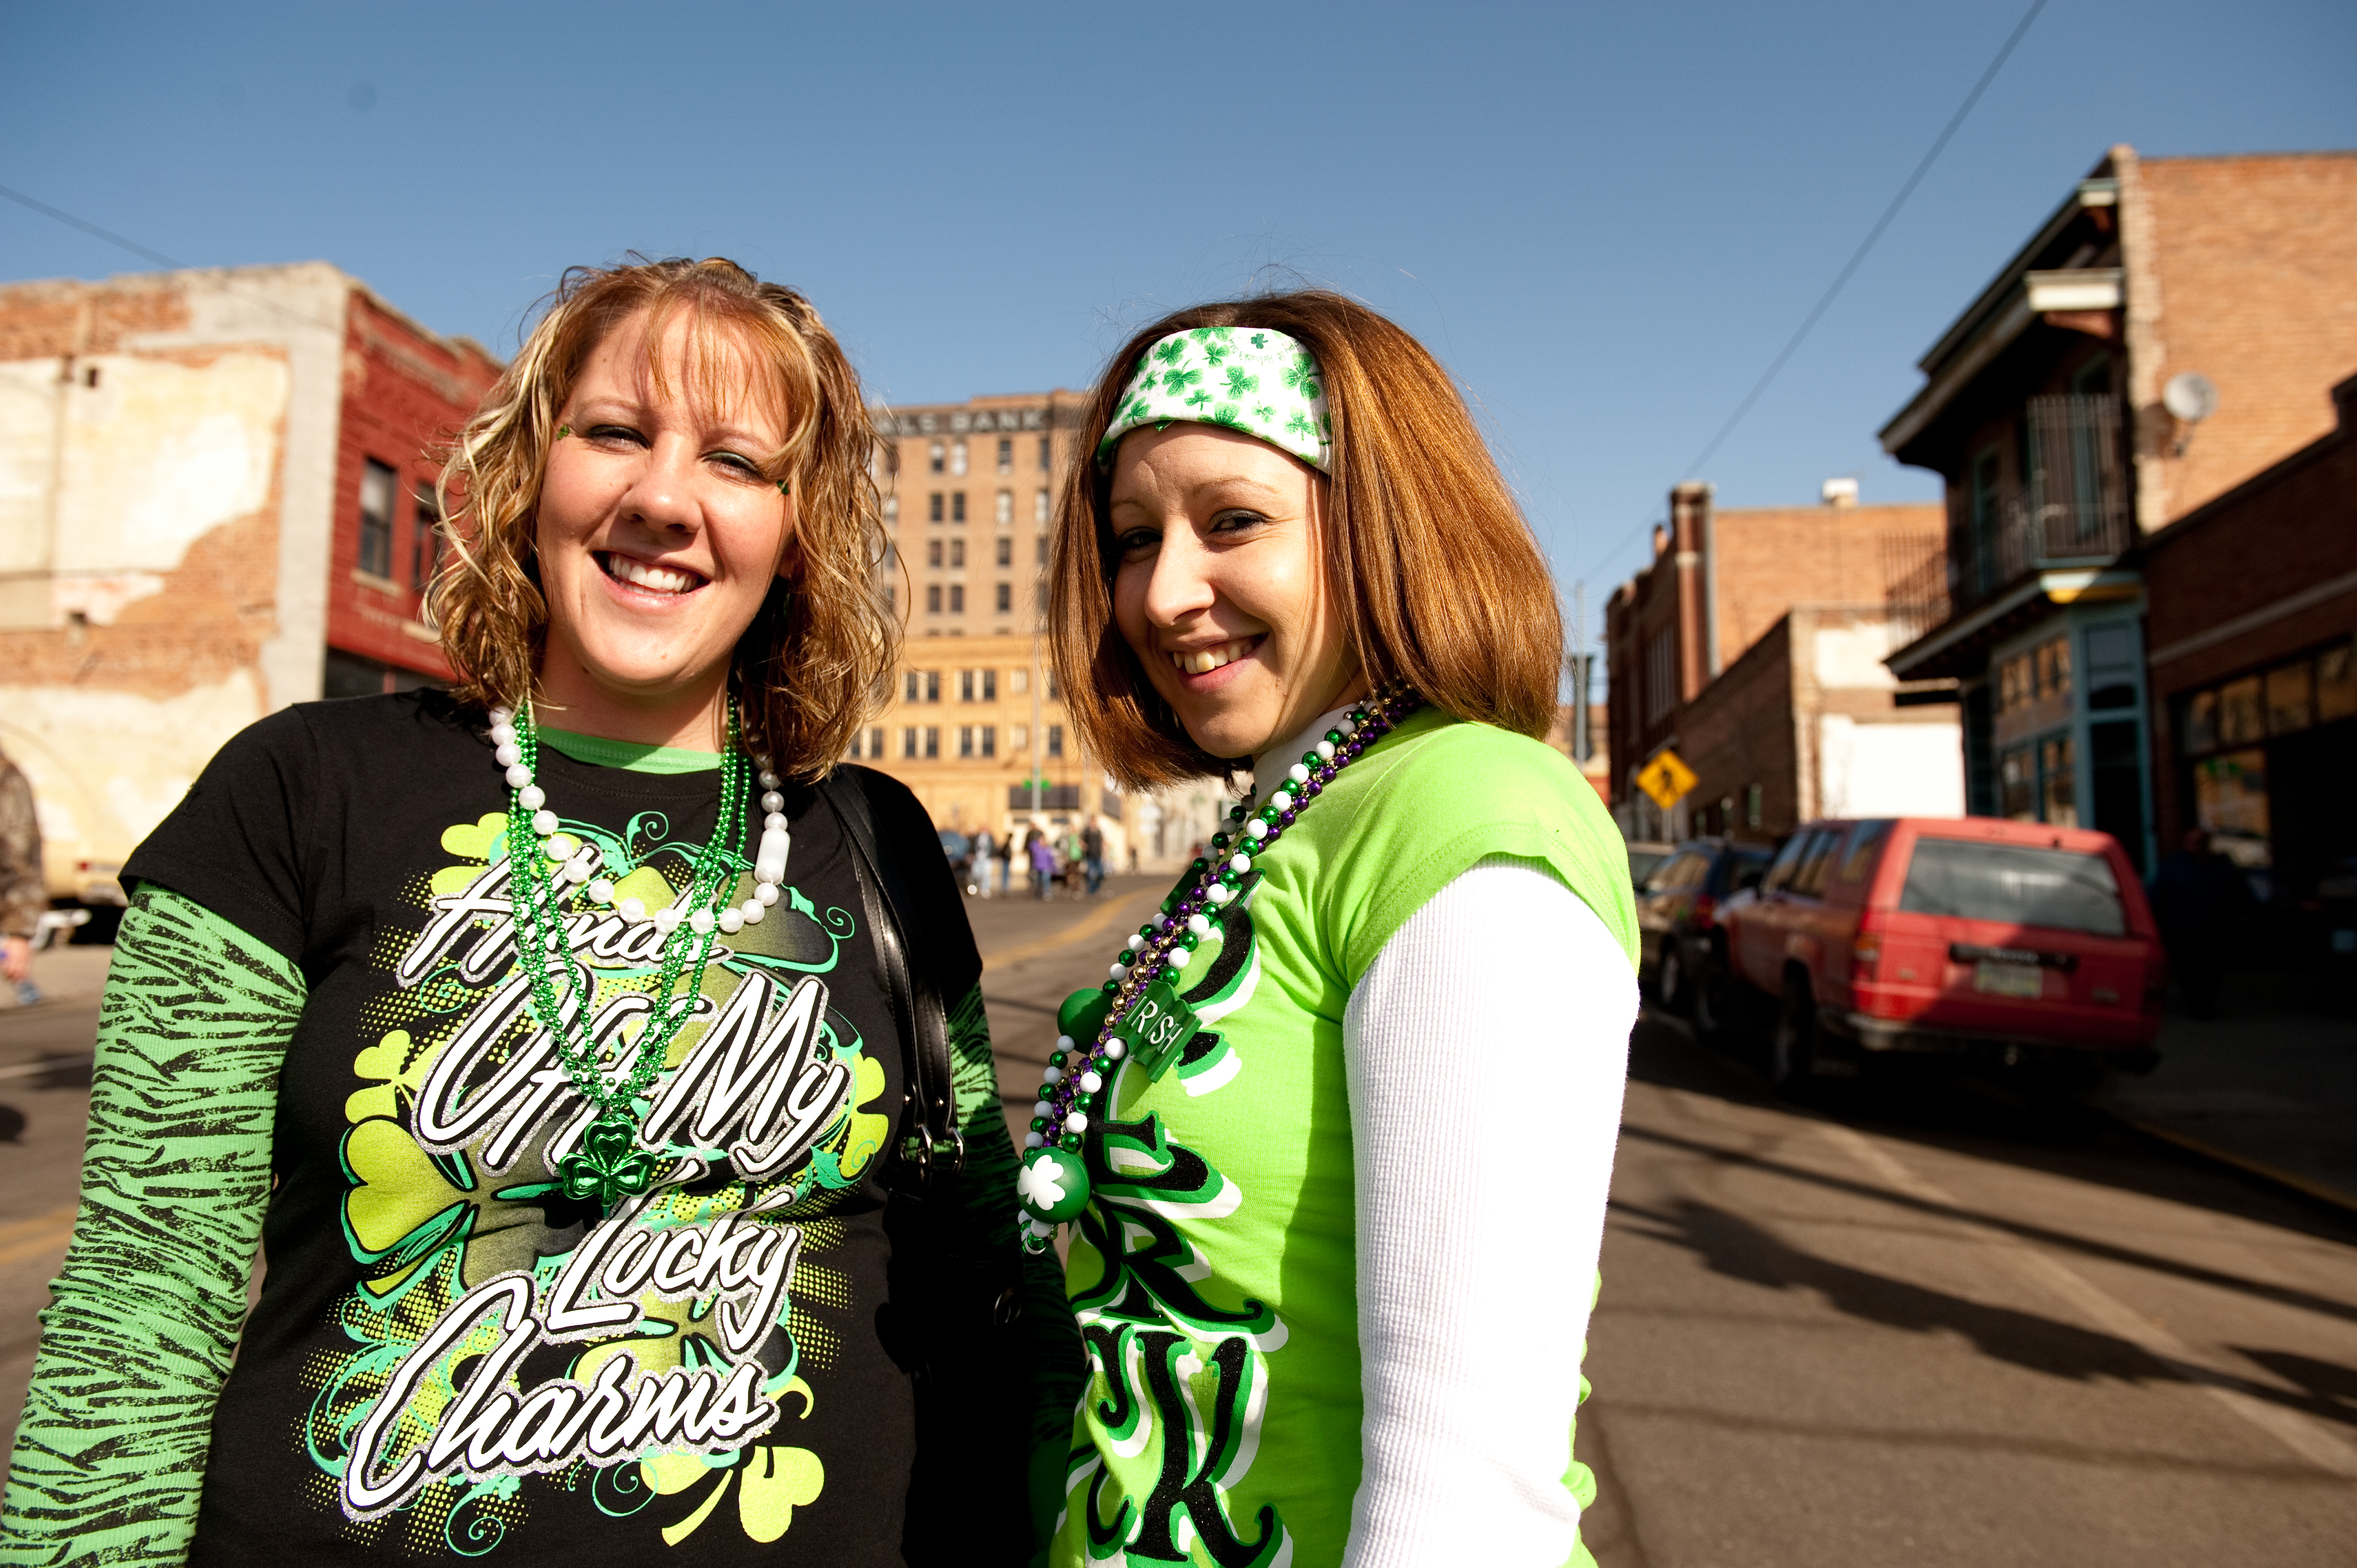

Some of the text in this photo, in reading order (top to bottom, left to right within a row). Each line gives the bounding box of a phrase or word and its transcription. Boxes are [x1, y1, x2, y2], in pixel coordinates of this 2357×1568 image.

[949, 408, 1048, 434] BANK
[640, 969, 848, 1173] My
[545, 1158, 801, 1352] Lucky
[344, 1273, 773, 1512] Charms
